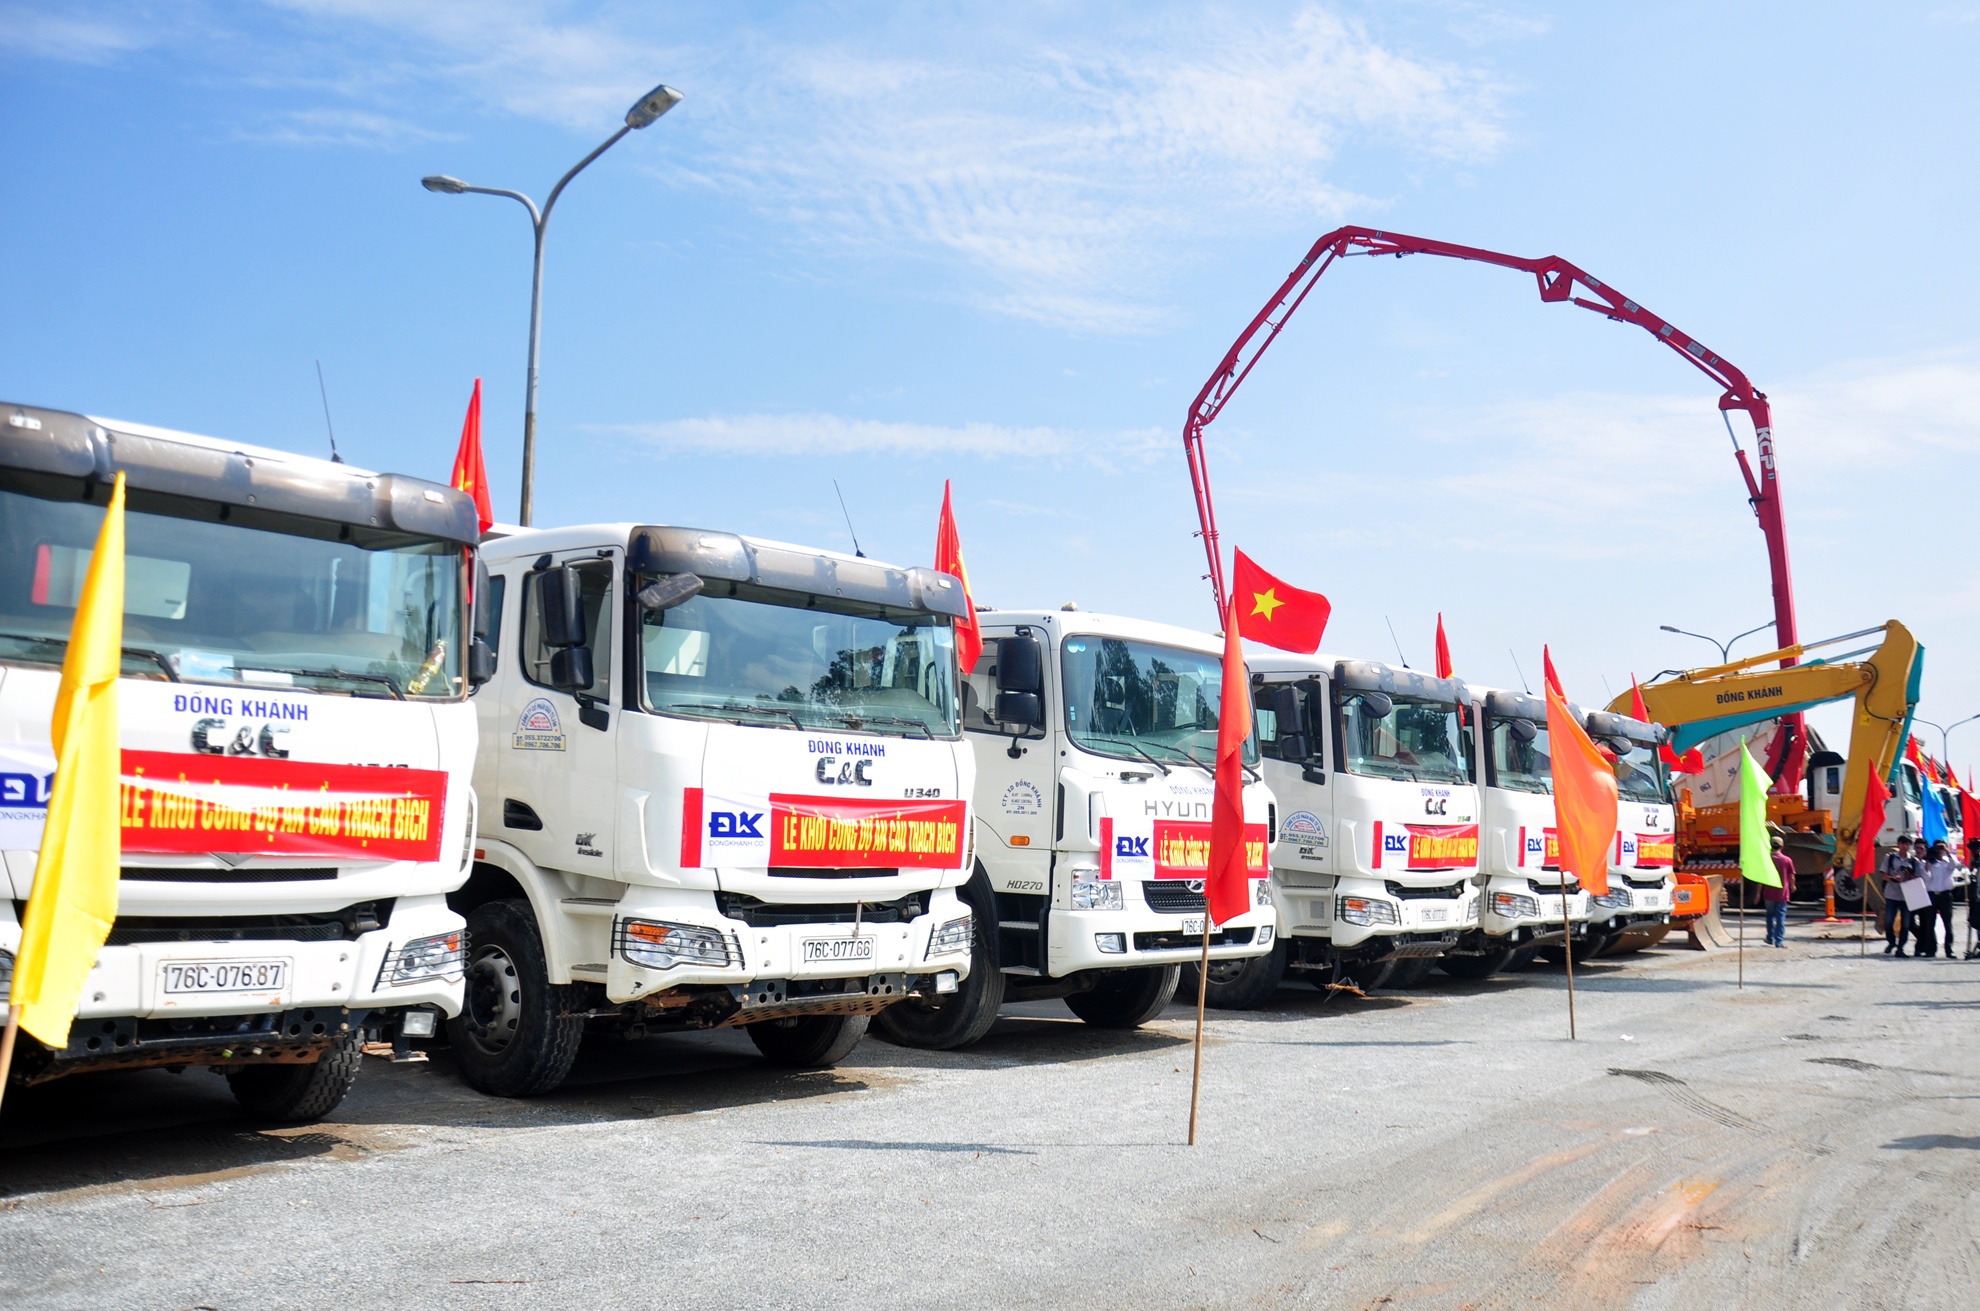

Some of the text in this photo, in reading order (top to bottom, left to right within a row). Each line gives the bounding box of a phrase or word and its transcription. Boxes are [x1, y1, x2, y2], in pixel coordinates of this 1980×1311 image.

[1756, 427, 1775, 469] KCP
[191, 718, 290, 759] C&C
[816, 757, 873, 786] C&C
[394, 791, 429, 841] BÍCH
[1144, 800, 1207, 818] HYUN
[1006, 880, 1043, 890] HD270
[808, 940, 870, 958] 76C-077.66
[171, 965, 280, 989] 76C-076.87
